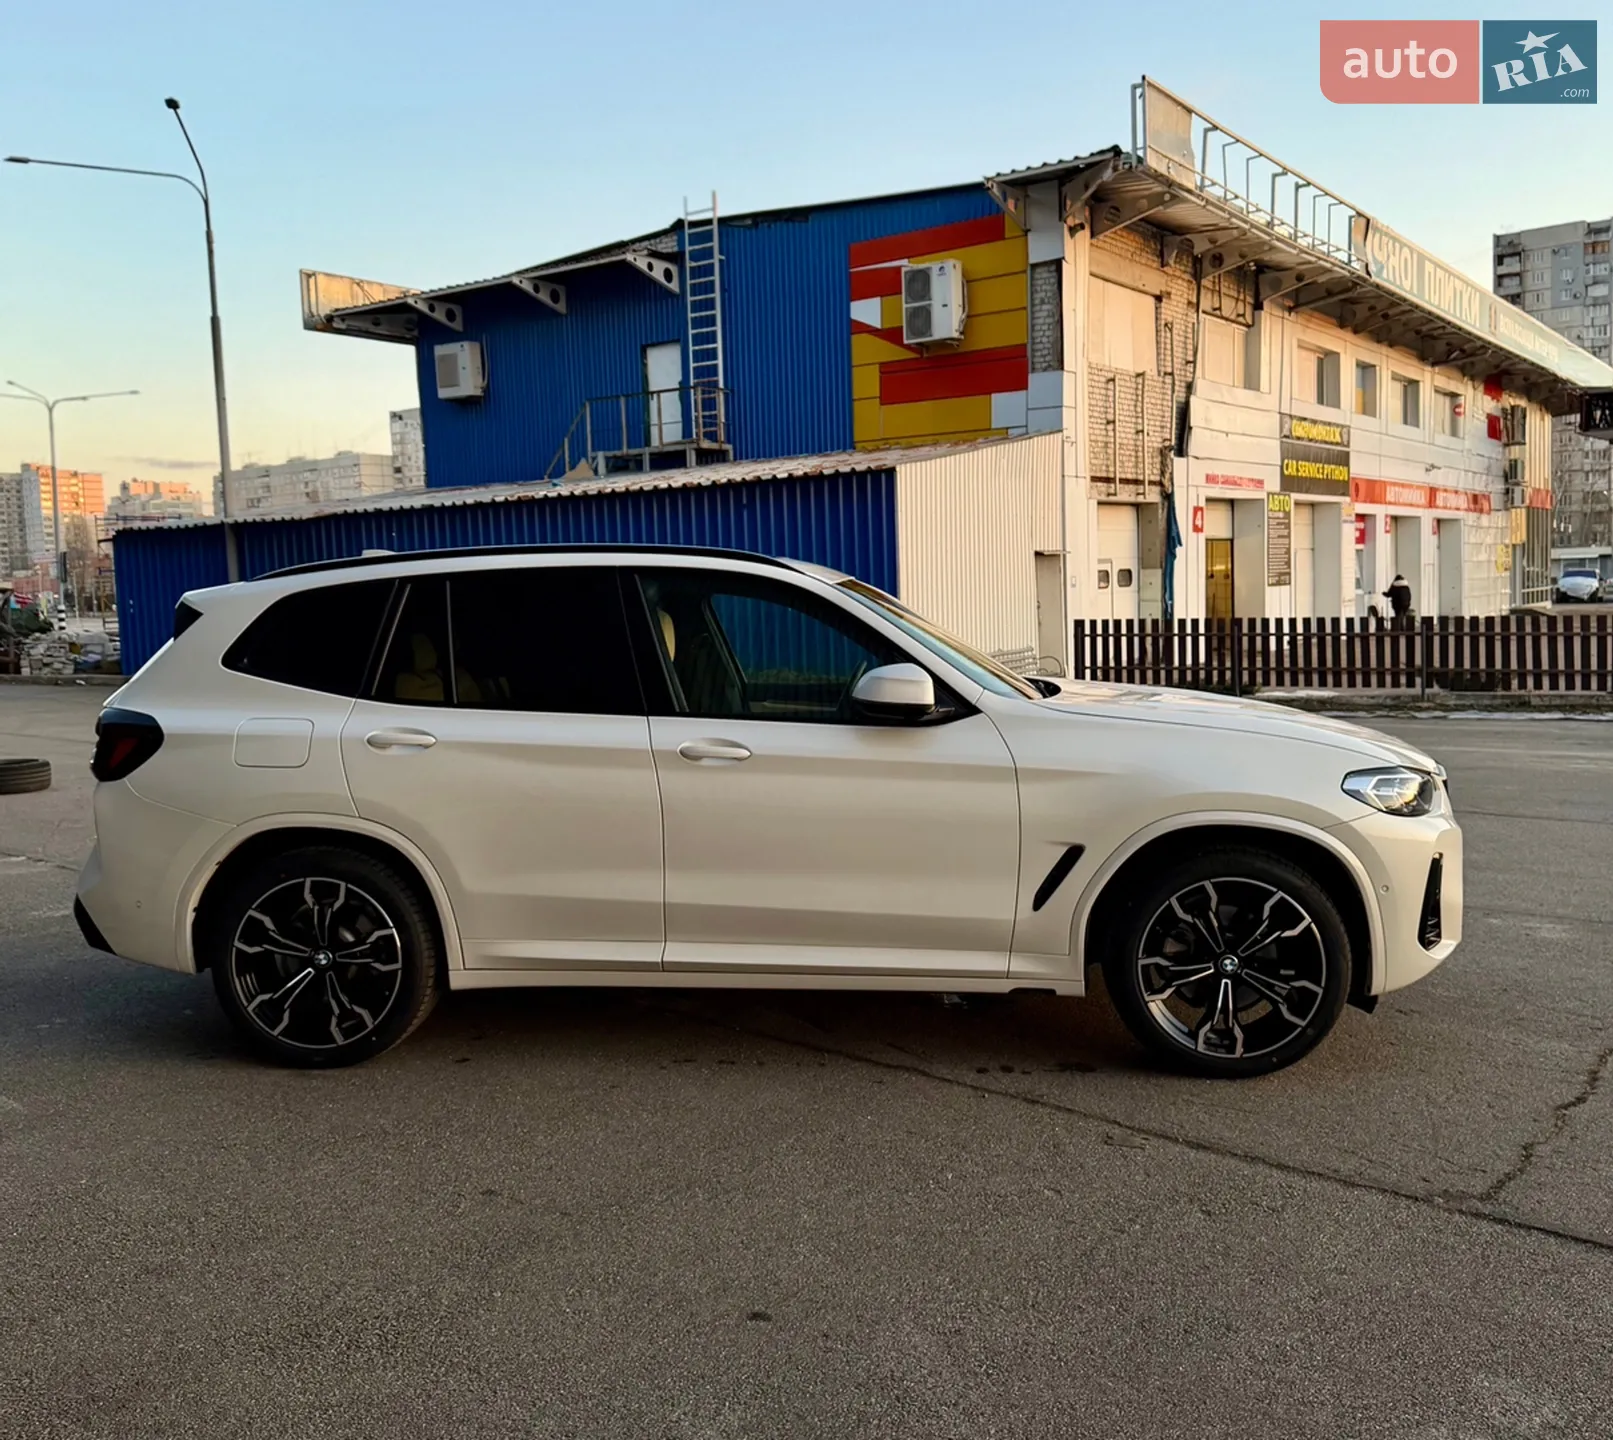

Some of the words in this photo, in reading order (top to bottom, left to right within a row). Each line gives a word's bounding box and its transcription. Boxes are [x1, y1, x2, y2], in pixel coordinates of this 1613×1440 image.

[1425, 260, 1480, 328] ПЛИТКИ
[1283, 458, 1297, 476] CAR
[1298, 460, 1323, 479] SERVICE
[1324, 464, 1349, 481] PYTHON
[1268, 494, 1291, 512] АВТО
[1194, 510, 1202, 529] 4
